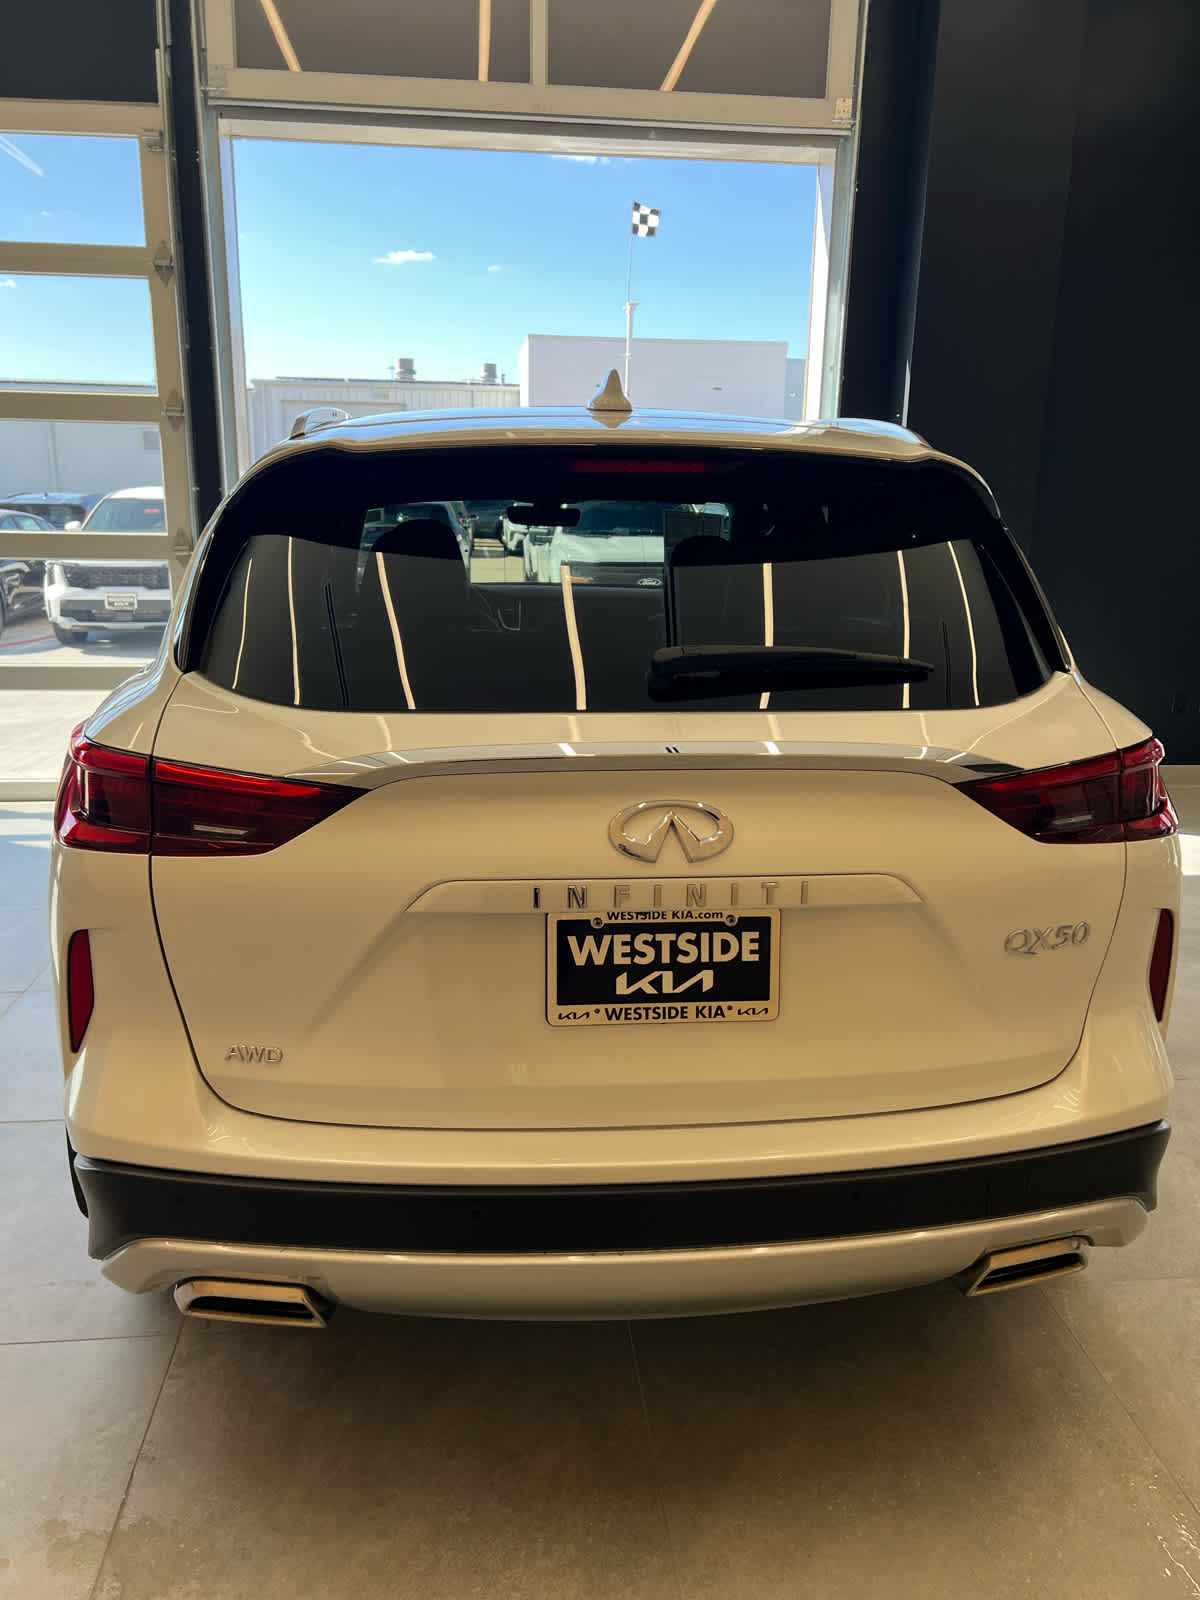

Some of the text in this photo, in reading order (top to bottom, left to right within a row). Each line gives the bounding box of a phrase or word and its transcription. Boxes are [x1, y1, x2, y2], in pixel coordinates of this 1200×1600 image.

[533, 880, 809, 909] INFINITI
[606, 910, 724, 921] WESTSIDE KIA.com
[567, 930, 760, 966] WESTSIDE
[1003, 920, 1091, 956] QX50
[615, 969, 714, 995] KIA
[605, 1005, 689, 1021] WESTSIDE
[695, 1005, 726, 1019] KIA
[224, 1044, 284, 1064] AWD
